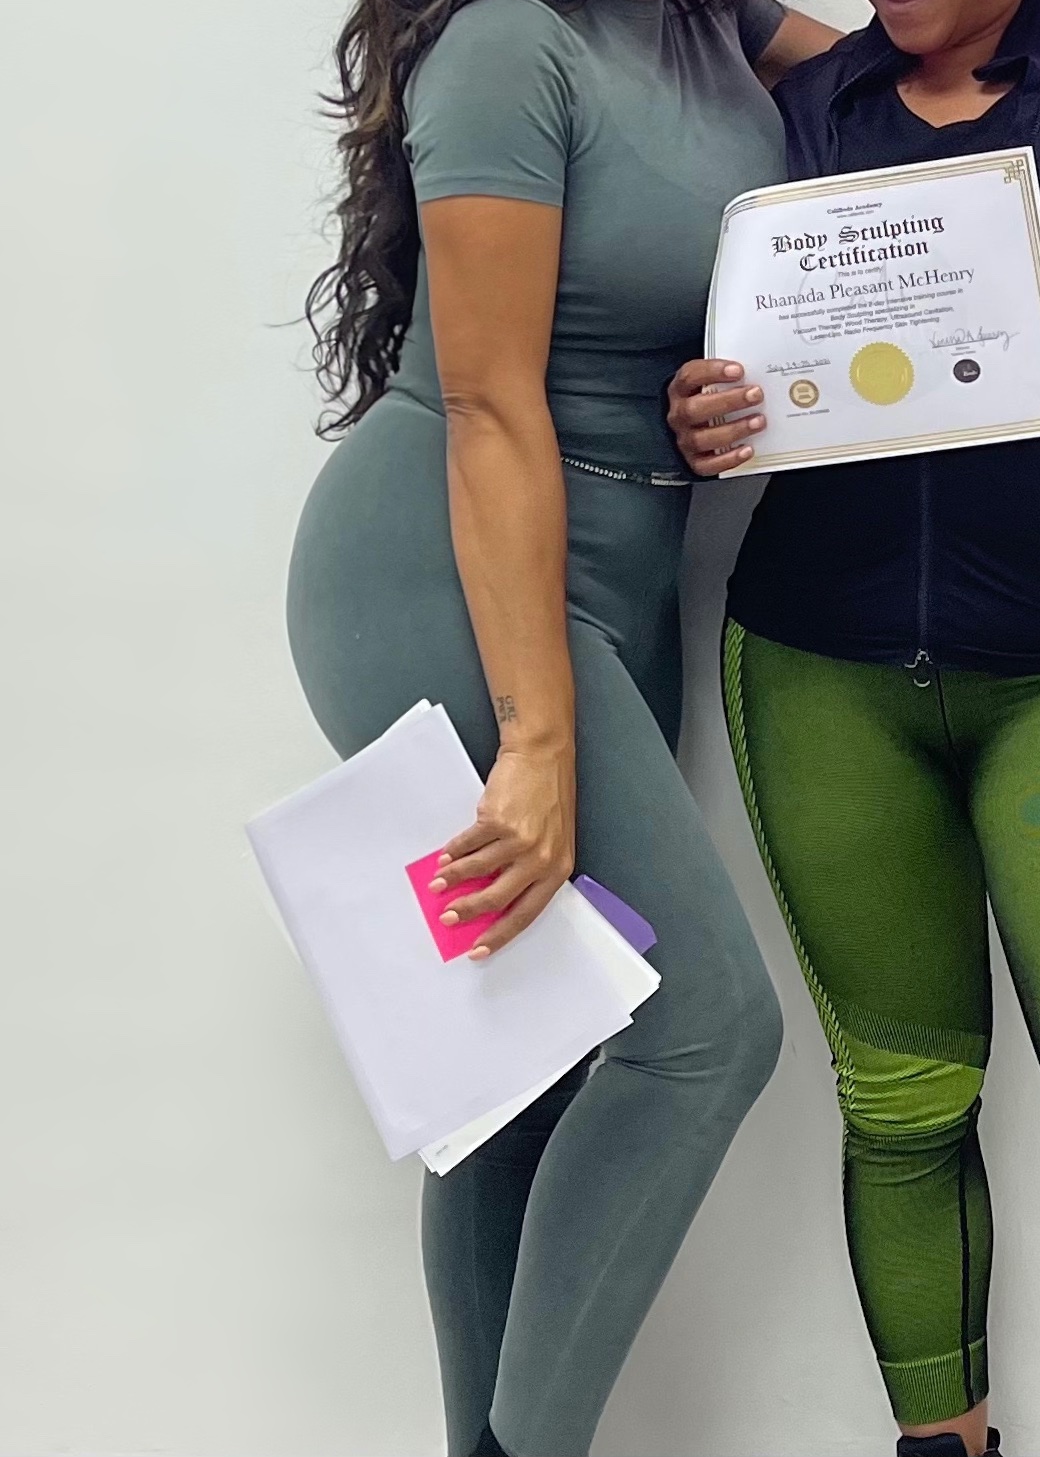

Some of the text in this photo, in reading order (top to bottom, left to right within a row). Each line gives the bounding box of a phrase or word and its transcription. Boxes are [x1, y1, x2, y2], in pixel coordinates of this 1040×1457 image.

[855, 202, 882, 210] Academy
[771, 215, 945, 257] Body Sculpting
[799, 240, 929, 272] Certification
[838, 270, 849, 278] This
[857, 268, 864, 276] to
[865, 266, 882, 275] certify
[755, 268, 975, 311] Rhanada Pleasant McHenry
[791, 308, 825, 319] successfully
[827, 304, 856, 314] completed
[887, 295, 912, 304] intensive
[913, 292, 935, 301] training
[830, 314, 845, 322] Body
[847, 309, 874, 319] Sculpting
[875, 304, 909, 314] specializing
[793, 327, 817, 335] Vacuum
[891, 311, 922, 320] Ultrasound
[844, 328, 861, 336] Radio
[863, 323, 893, 333] Frequency
[895, 320, 908, 328] Skin
[909, 316, 940, 326] Tightening
